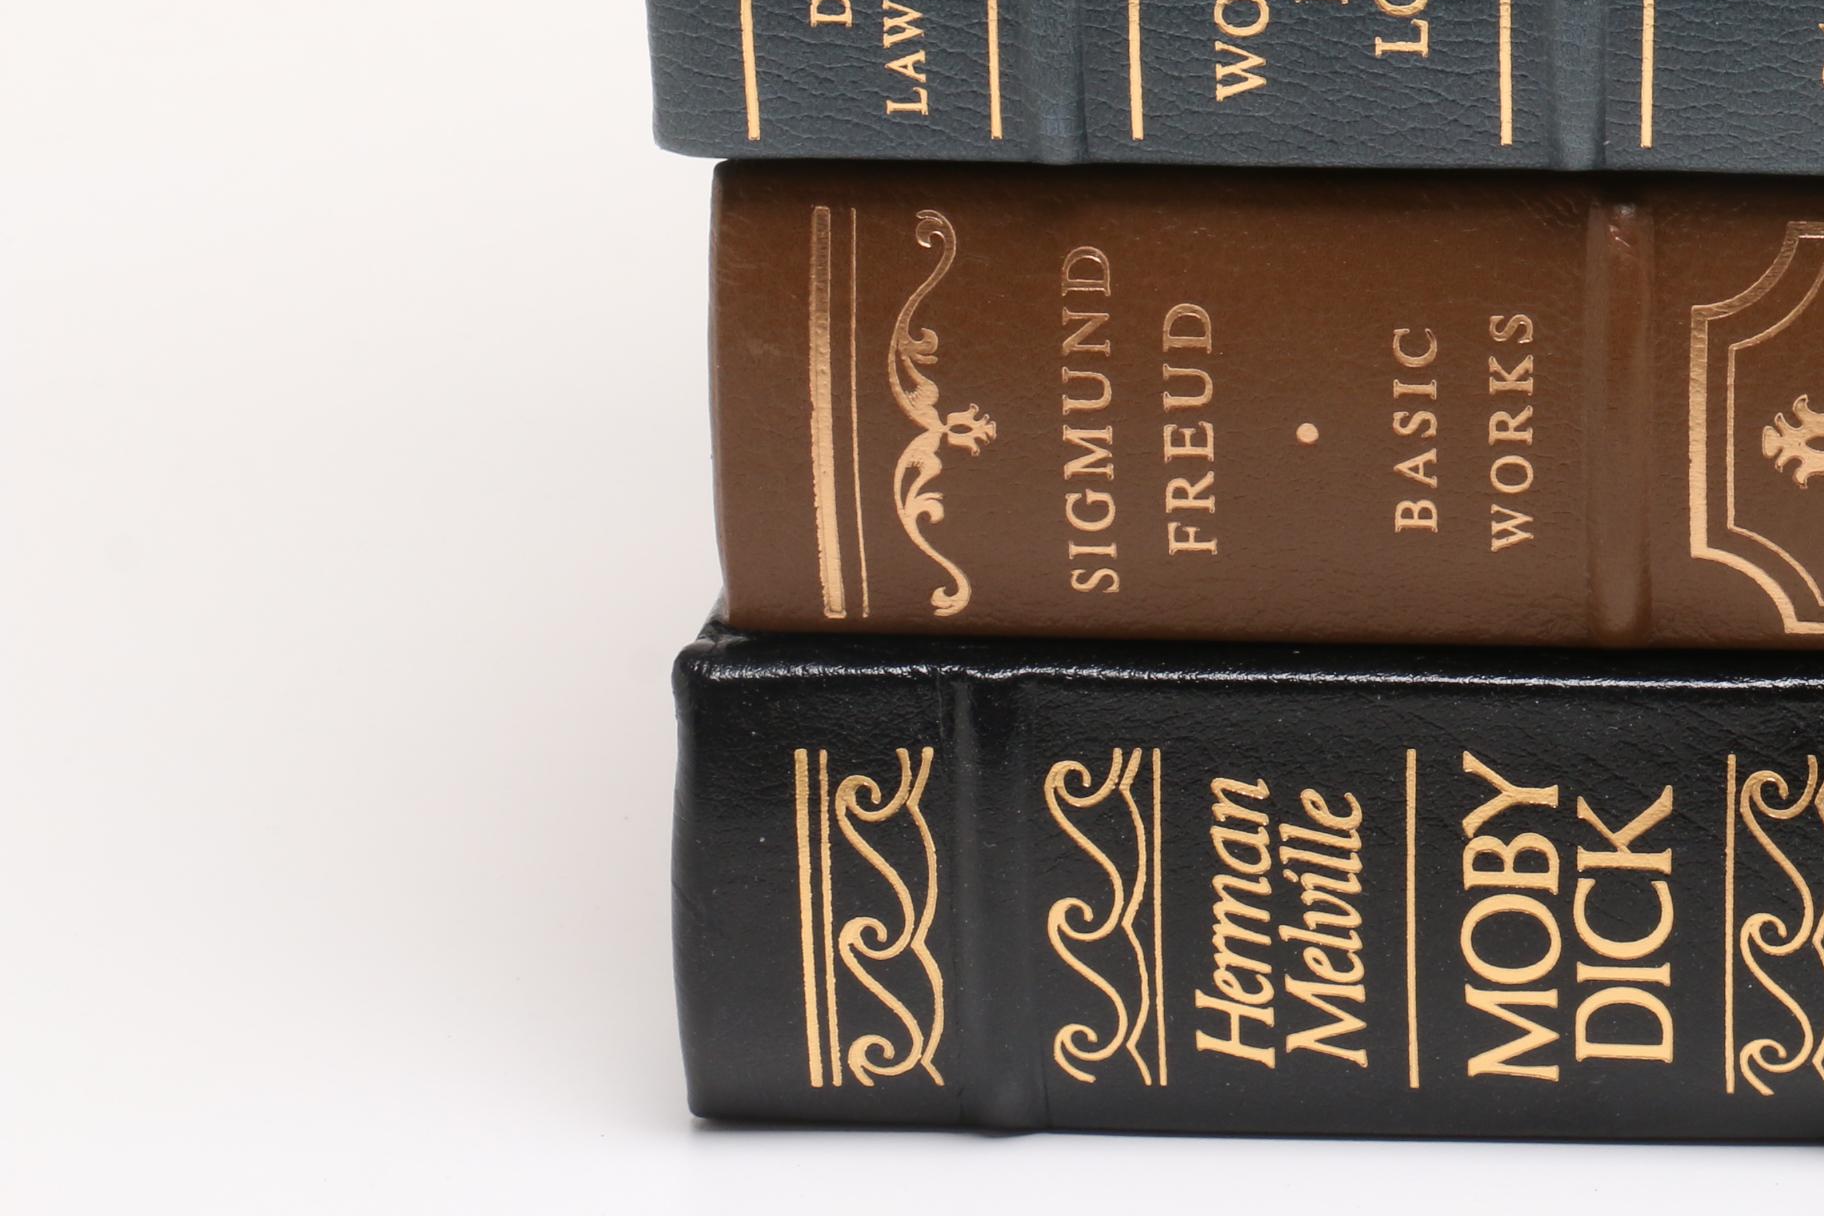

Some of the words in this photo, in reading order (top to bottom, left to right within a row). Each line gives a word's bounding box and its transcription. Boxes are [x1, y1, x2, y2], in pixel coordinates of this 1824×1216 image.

[1061, 245, 1120, 593] SIGMUND
[1161, 301, 1219, 557] FREUD
[1392, 327, 1440, 534] BASIC
[1487, 312, 1535, 553] WORKS
[1193, 776, 1276, 1071] Herman
[1278, 787, 1370, 1070] Melville
[1458, 749, 1563, 1084] MOBY
[1572, 783, 1676, 1065] DICK
